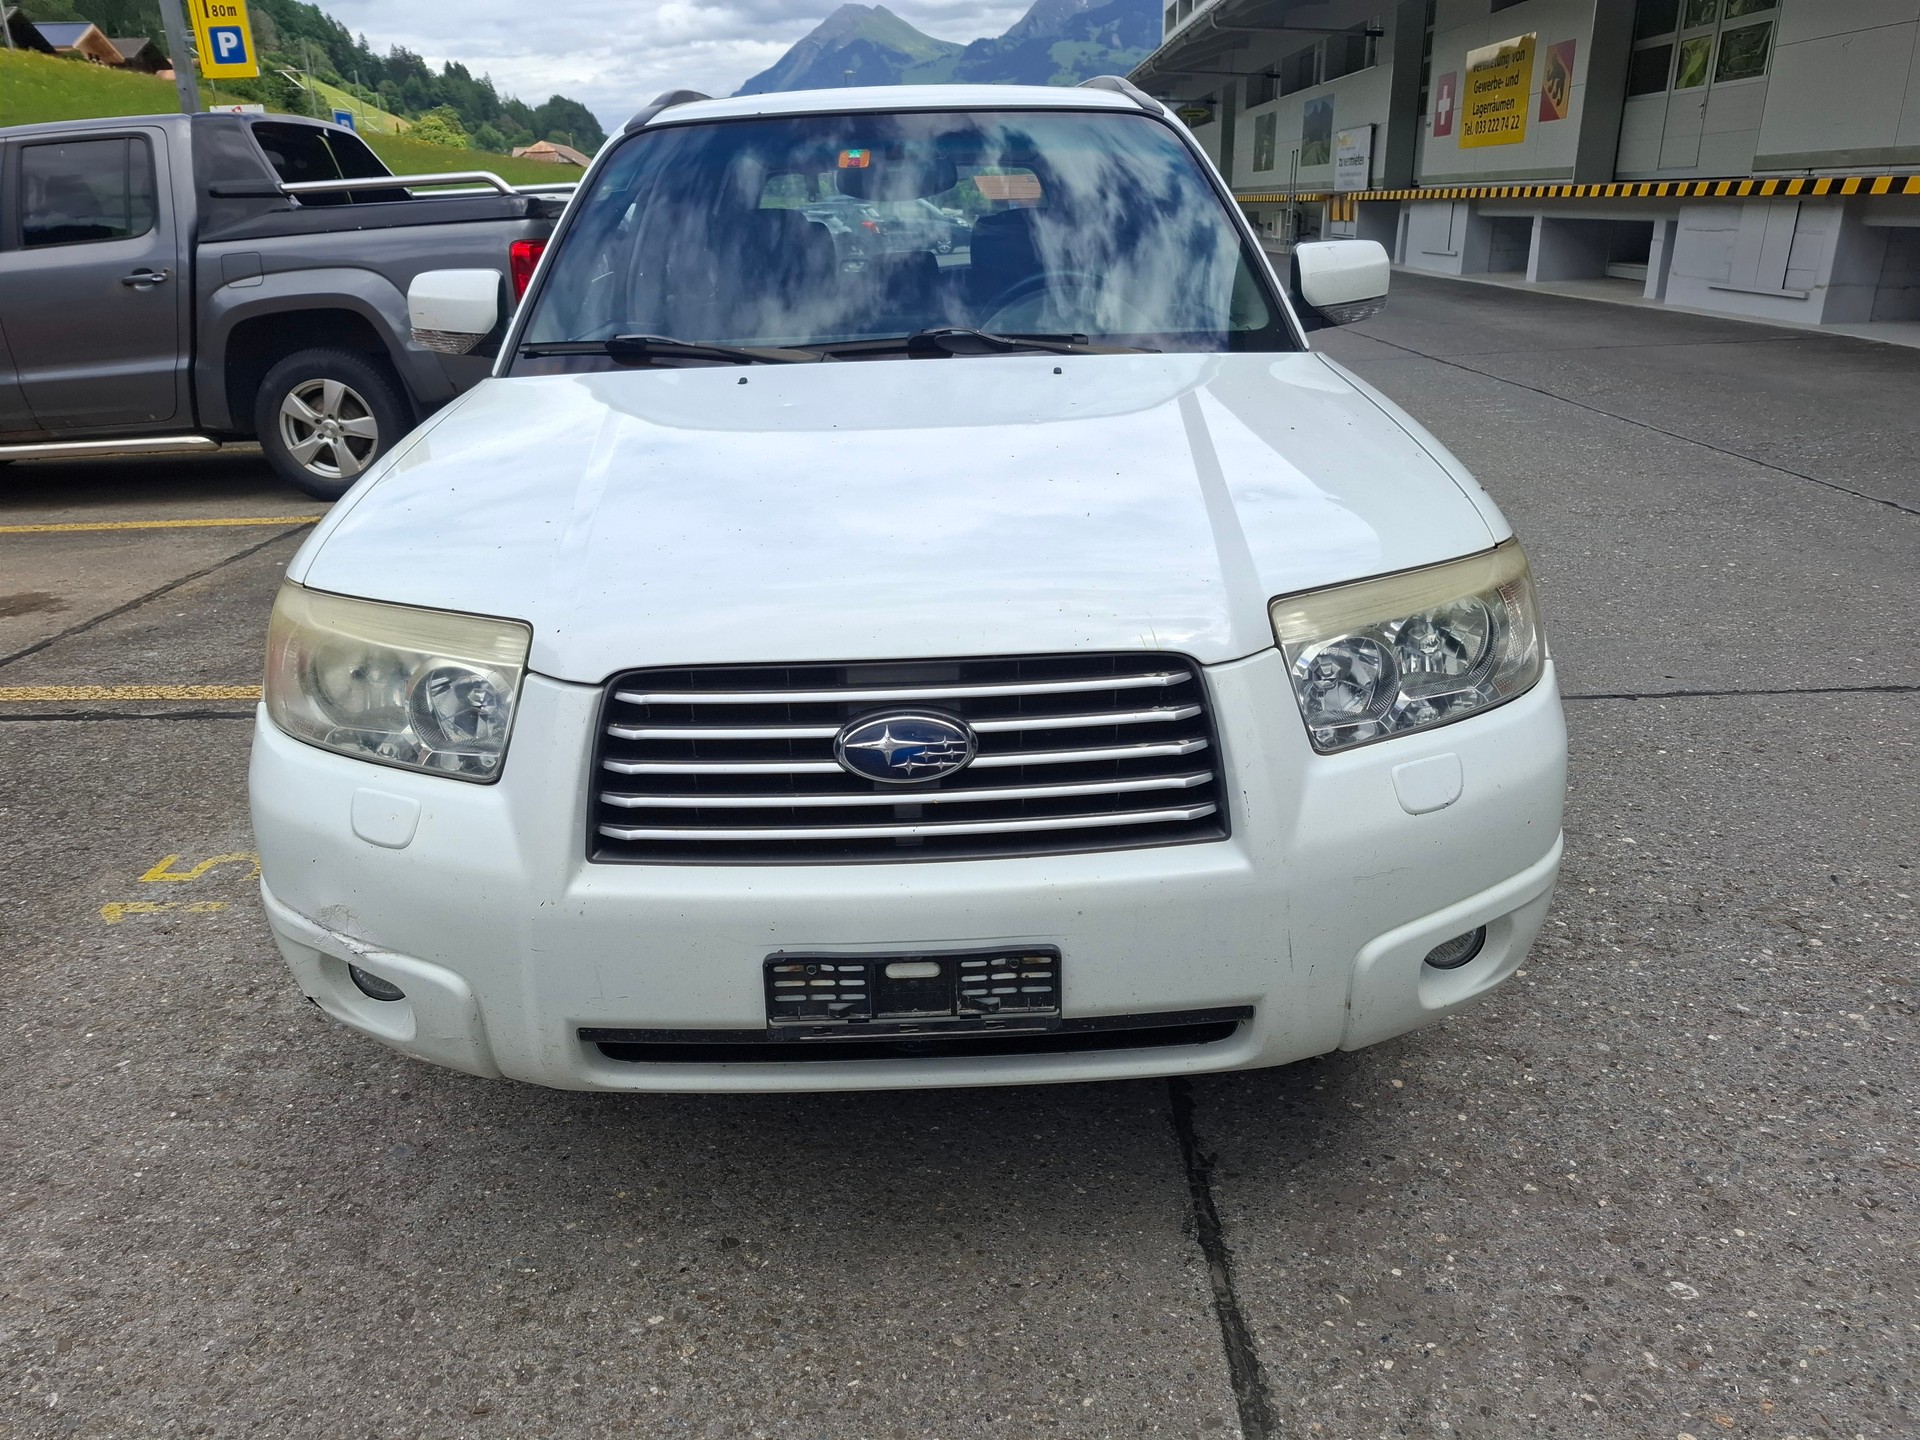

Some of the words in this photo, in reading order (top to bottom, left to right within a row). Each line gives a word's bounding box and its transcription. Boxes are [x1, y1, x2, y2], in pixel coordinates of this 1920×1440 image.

[211, 5, 237, 17] 80m
[216, 31, 238, 57] P
[1512, 50, 1525, 62] von
[1474, 75, 1504, 94] Gewerbe-
[1505, 69, 1520, 87] und
[1464, 121, 1473, 136] Tel.
[1475, 120, 1487, 135] 033
[1488, 118, 1499, 133] 222
[1501, 116, 1510, 131] 74
[1511, 115, 1521, 130] 22
